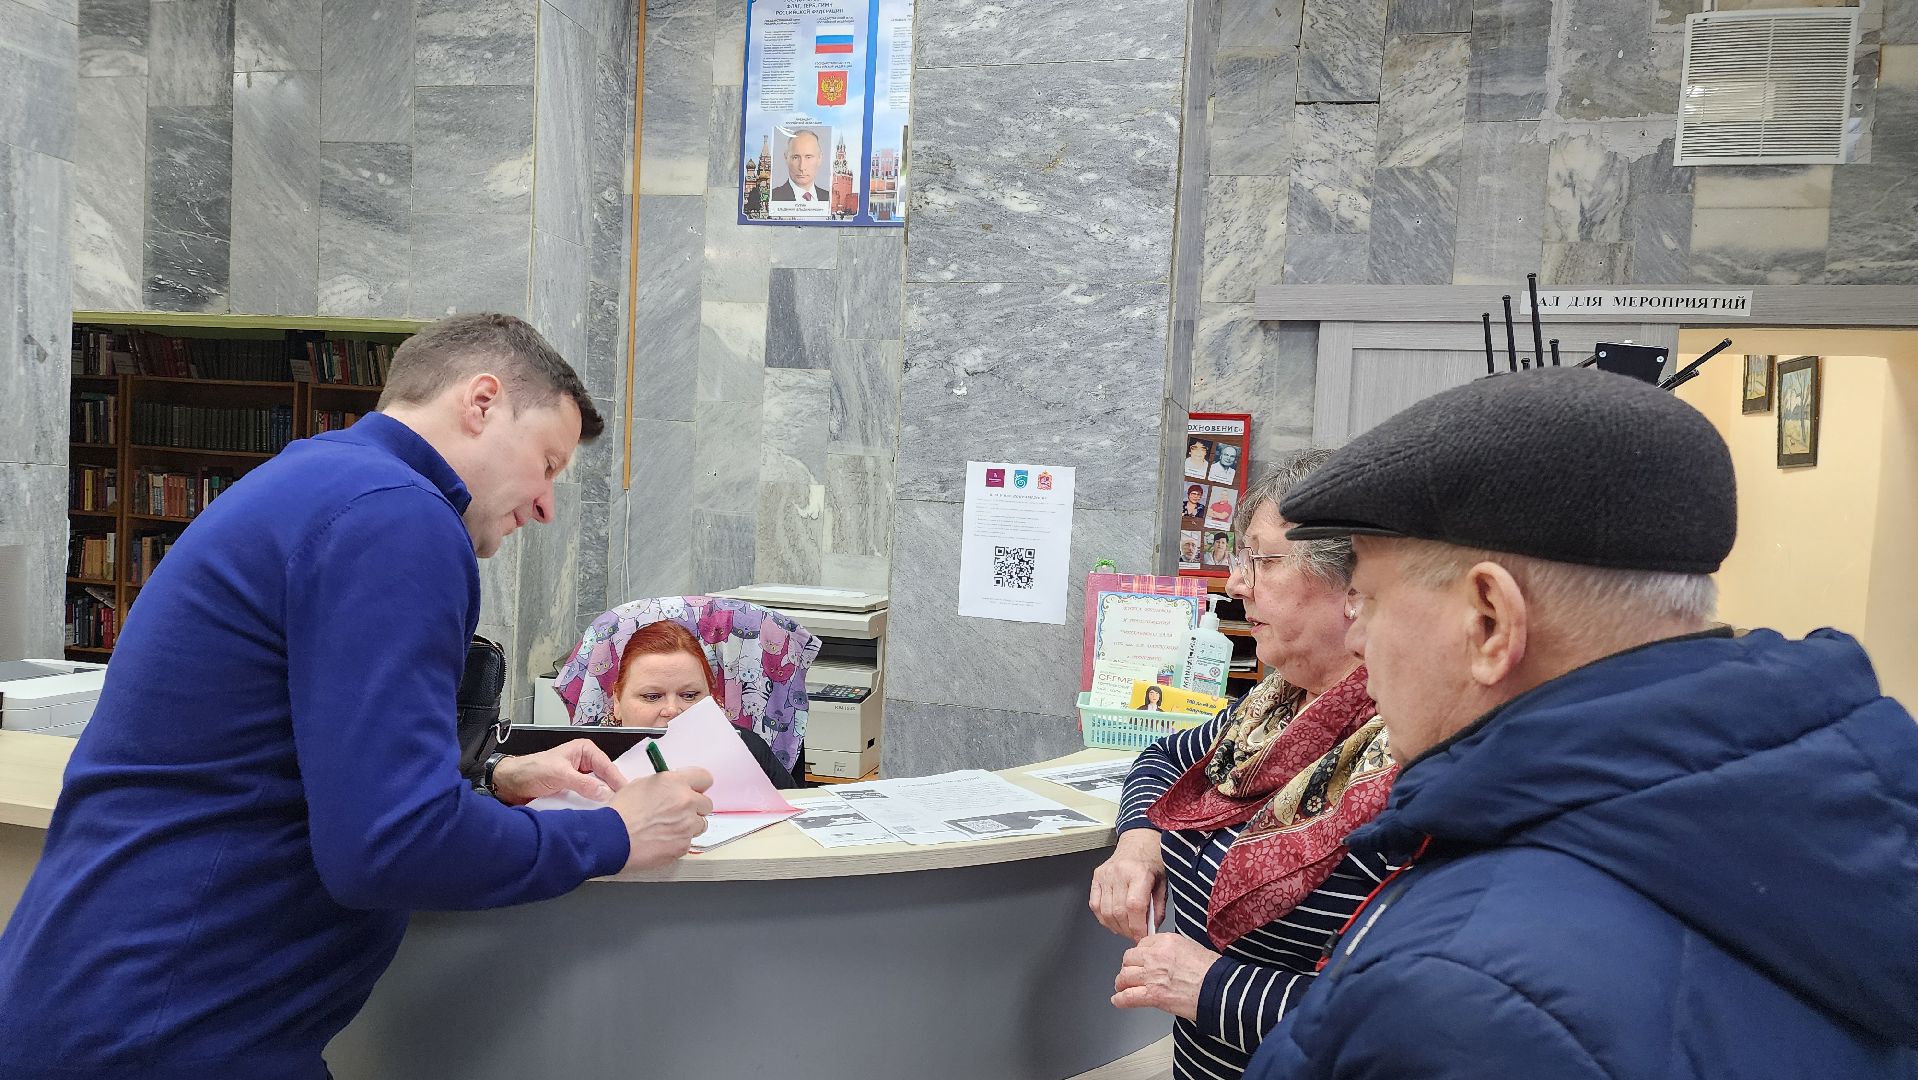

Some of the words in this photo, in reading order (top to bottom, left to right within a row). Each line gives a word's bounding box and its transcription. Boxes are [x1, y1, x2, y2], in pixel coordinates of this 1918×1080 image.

[1536, 296, 1560, 307] АЛ
[1567, 296, 1603, 308] ДЛЯ
[1613, 296, 1747, 310] МЕРОПРИЯТИЙ
